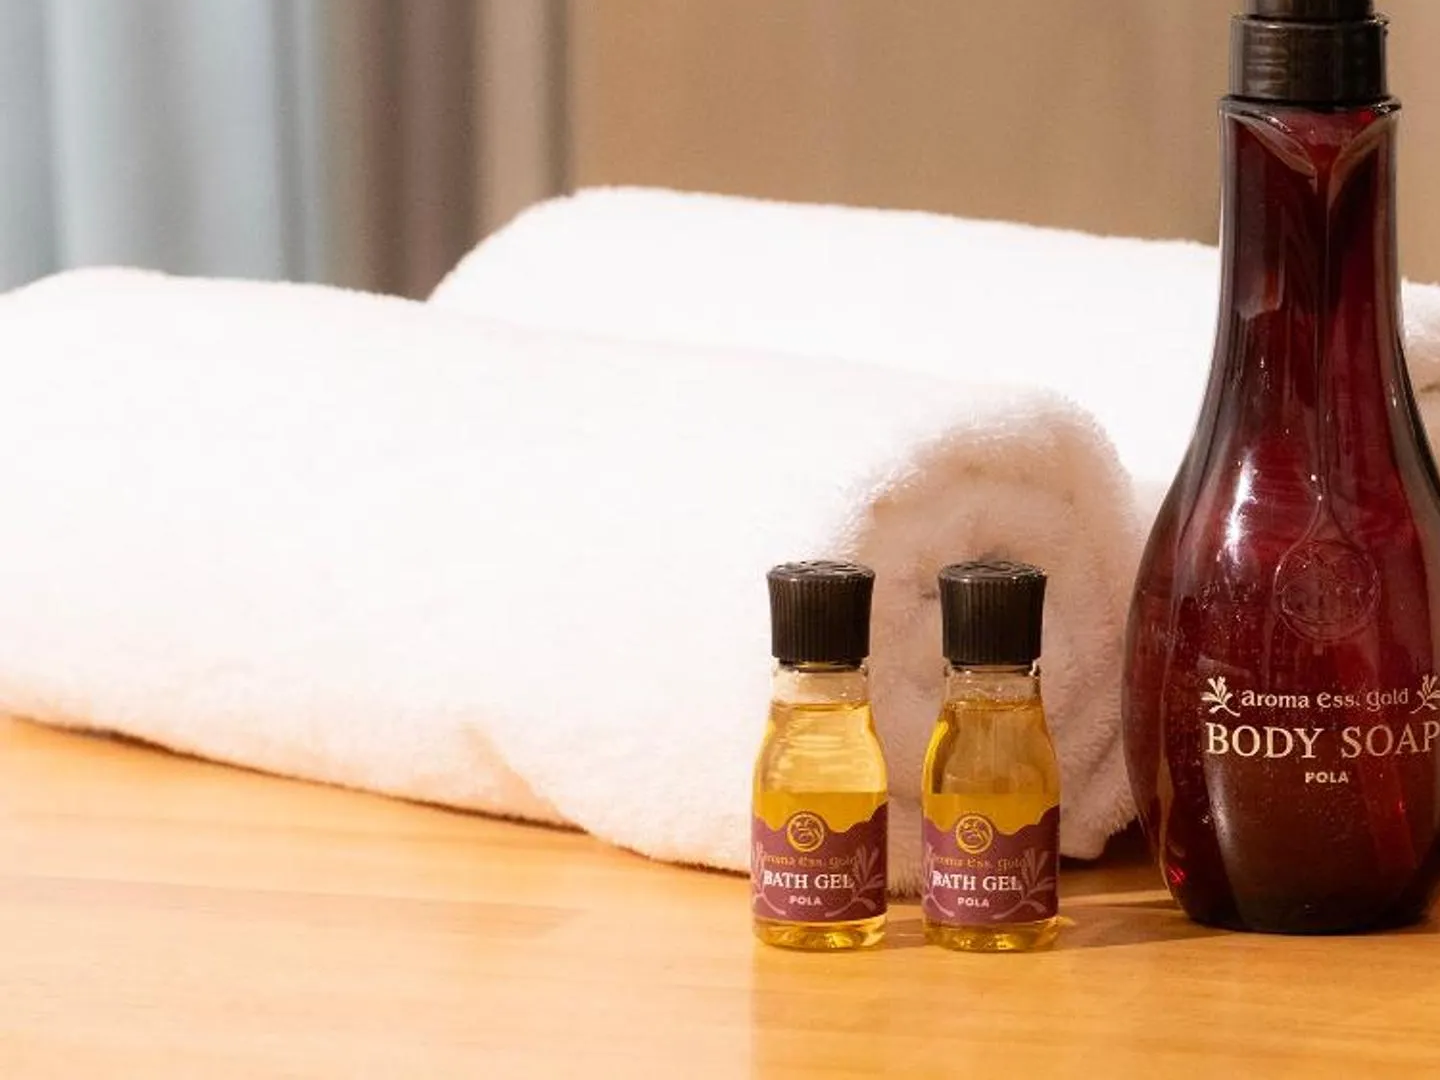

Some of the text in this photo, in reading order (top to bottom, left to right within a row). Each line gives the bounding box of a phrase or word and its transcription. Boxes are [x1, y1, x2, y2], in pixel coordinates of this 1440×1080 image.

[1241, 688, 1409, 712] aroma ess. gold
[1205, 722, 1324, 759] BODY
[1305, 772, 1349, 783] POLA
[763, 870, 855, 889] BATH GEL
[931, 870, 1022, 891] BATH GEL
[788, 895, 822, 906] POLA
[957, 897, 990, 908] POLA
